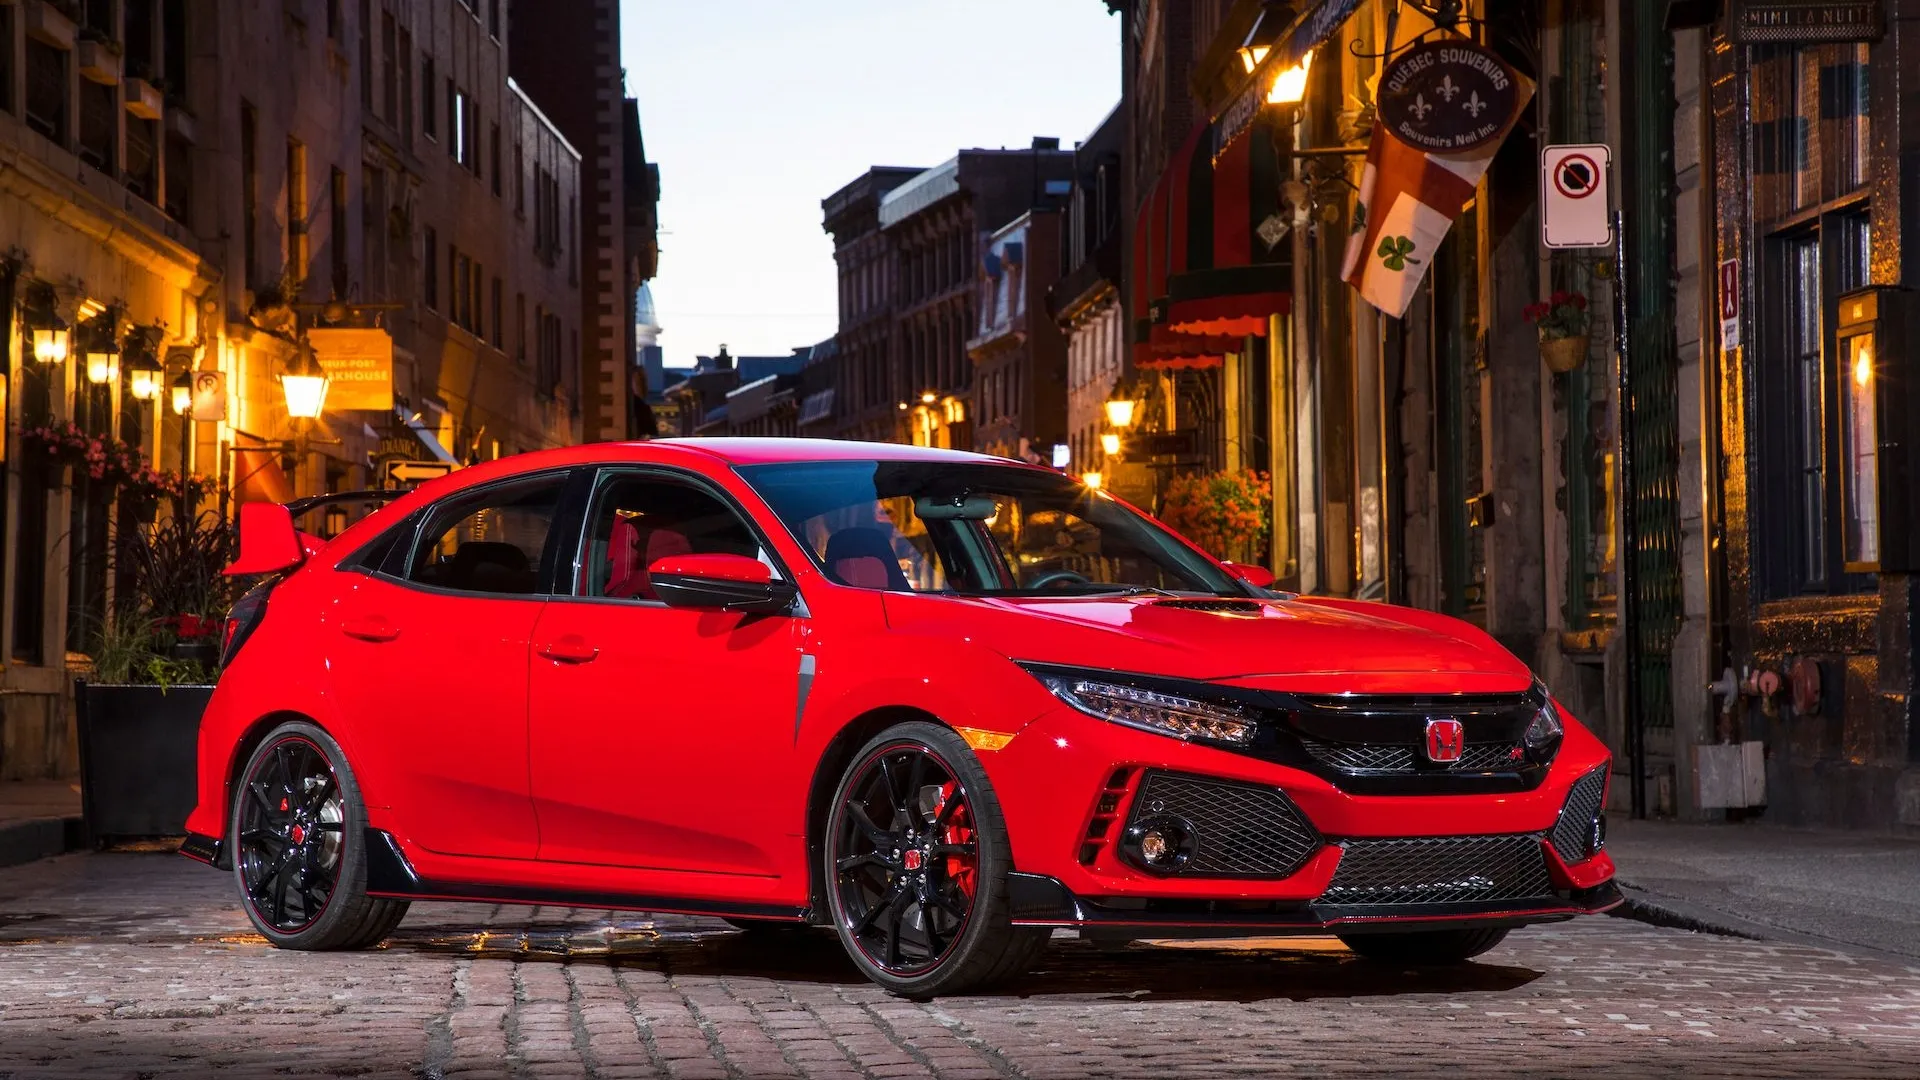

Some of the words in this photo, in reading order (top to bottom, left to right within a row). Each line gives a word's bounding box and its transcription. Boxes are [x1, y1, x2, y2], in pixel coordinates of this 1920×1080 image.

[1750, 10, 1789, 24] MIMI
[1822, 8, 1864, 23] NUIT
[1440, 48, 1509, 91] SOUVENIRS
[1399, 121, 1452, 147] Souvenirs
[1455, 133, 1477, 146] Neil
[1479, 123, 1498, 138] Inc.
